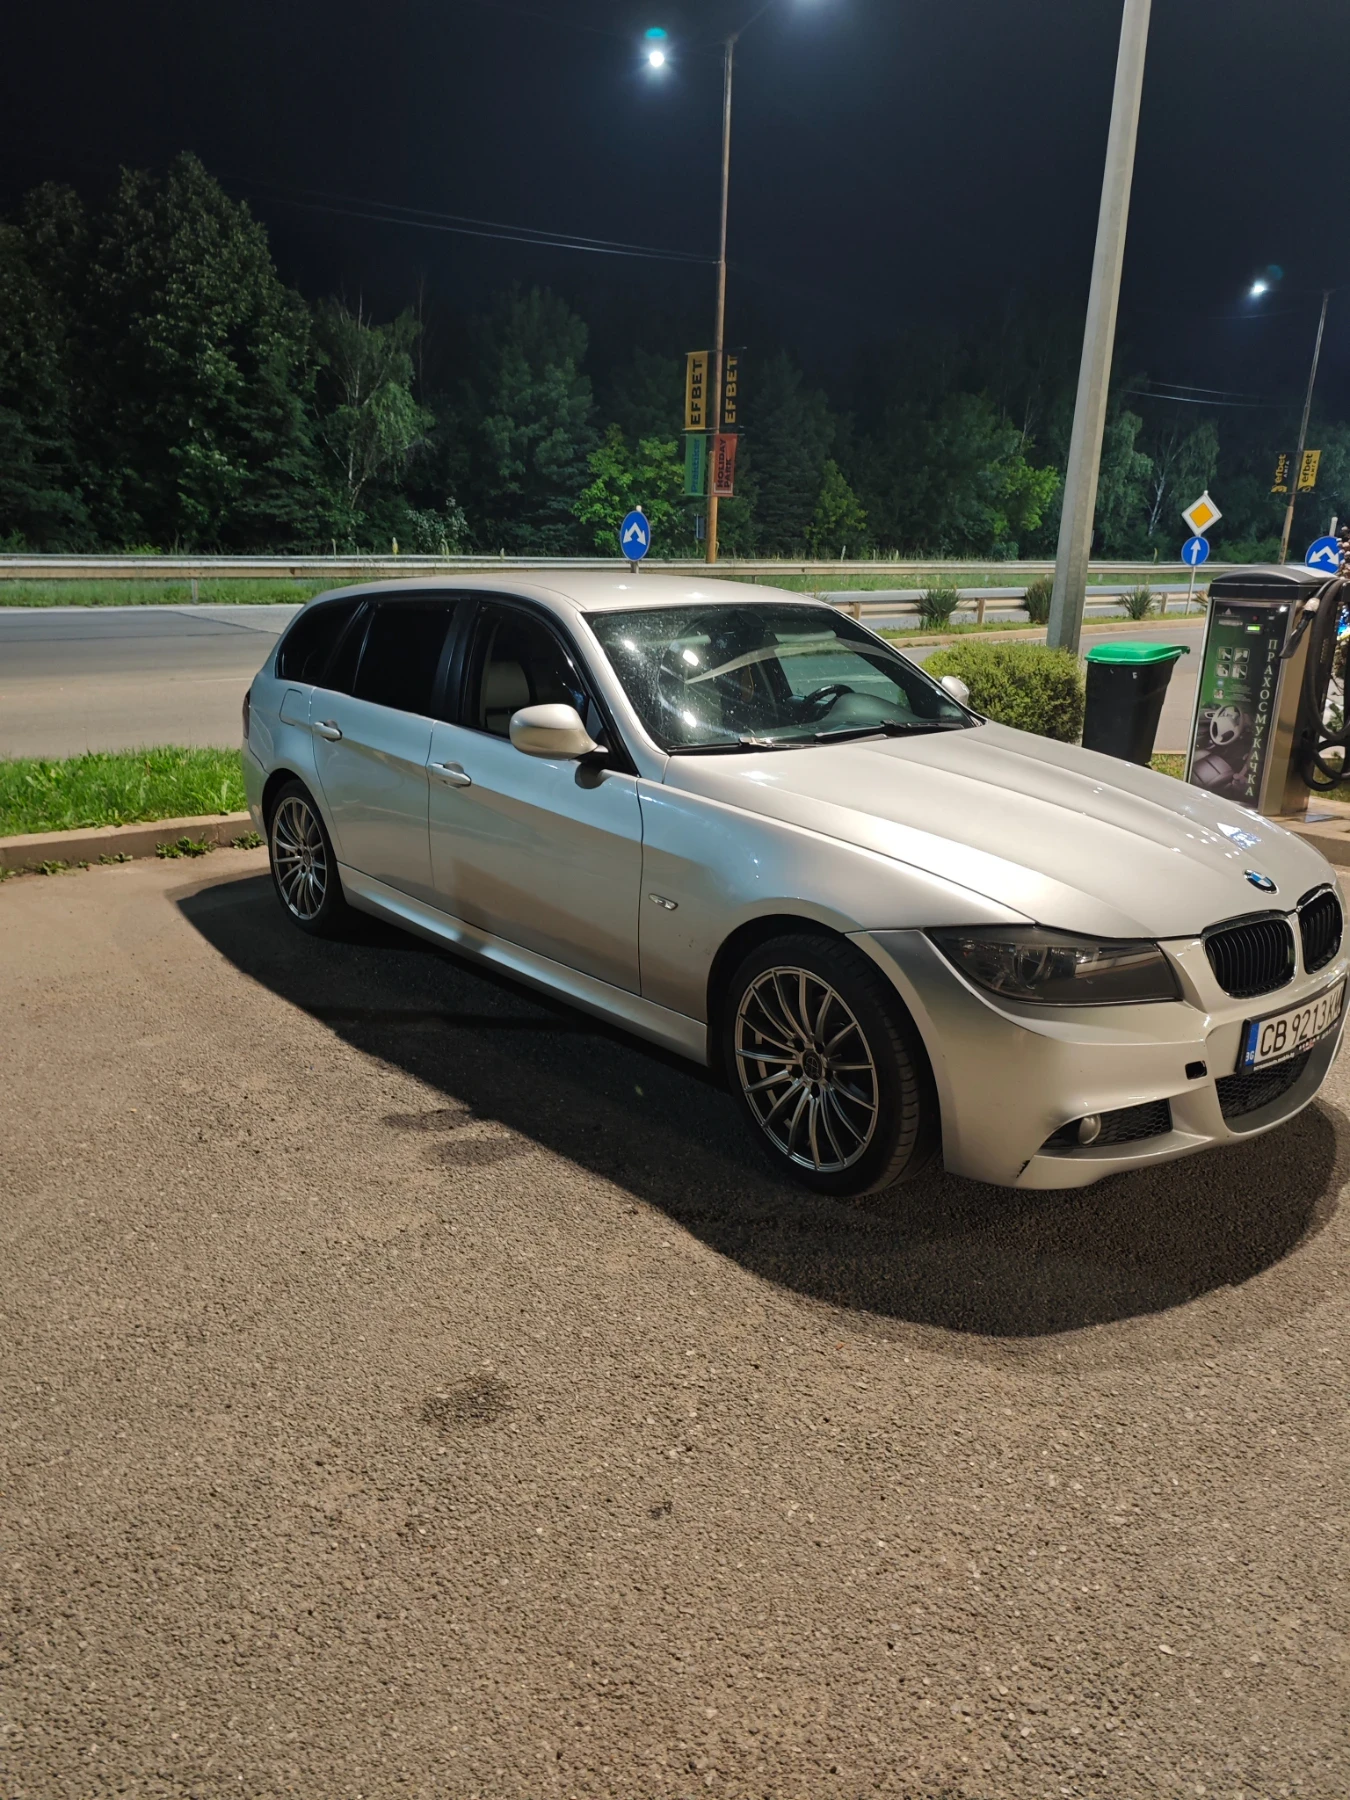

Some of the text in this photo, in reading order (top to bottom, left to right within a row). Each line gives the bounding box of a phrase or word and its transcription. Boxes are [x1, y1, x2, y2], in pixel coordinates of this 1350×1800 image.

[691, 359, 702, 425] EFBET
[725, 355, 738, 423] EFBET
[717, 438, 727, 488] HOLIDAY
[724, 458, 732, 488] PARK
[1275, 453, 1287, 483] efbet
[1302, 453, 1313, 482] efbet
[1245, 639, 1278, 797] ПРАХОСМУКАЧКА
[1261, 1020, 1287, 1056] CB
